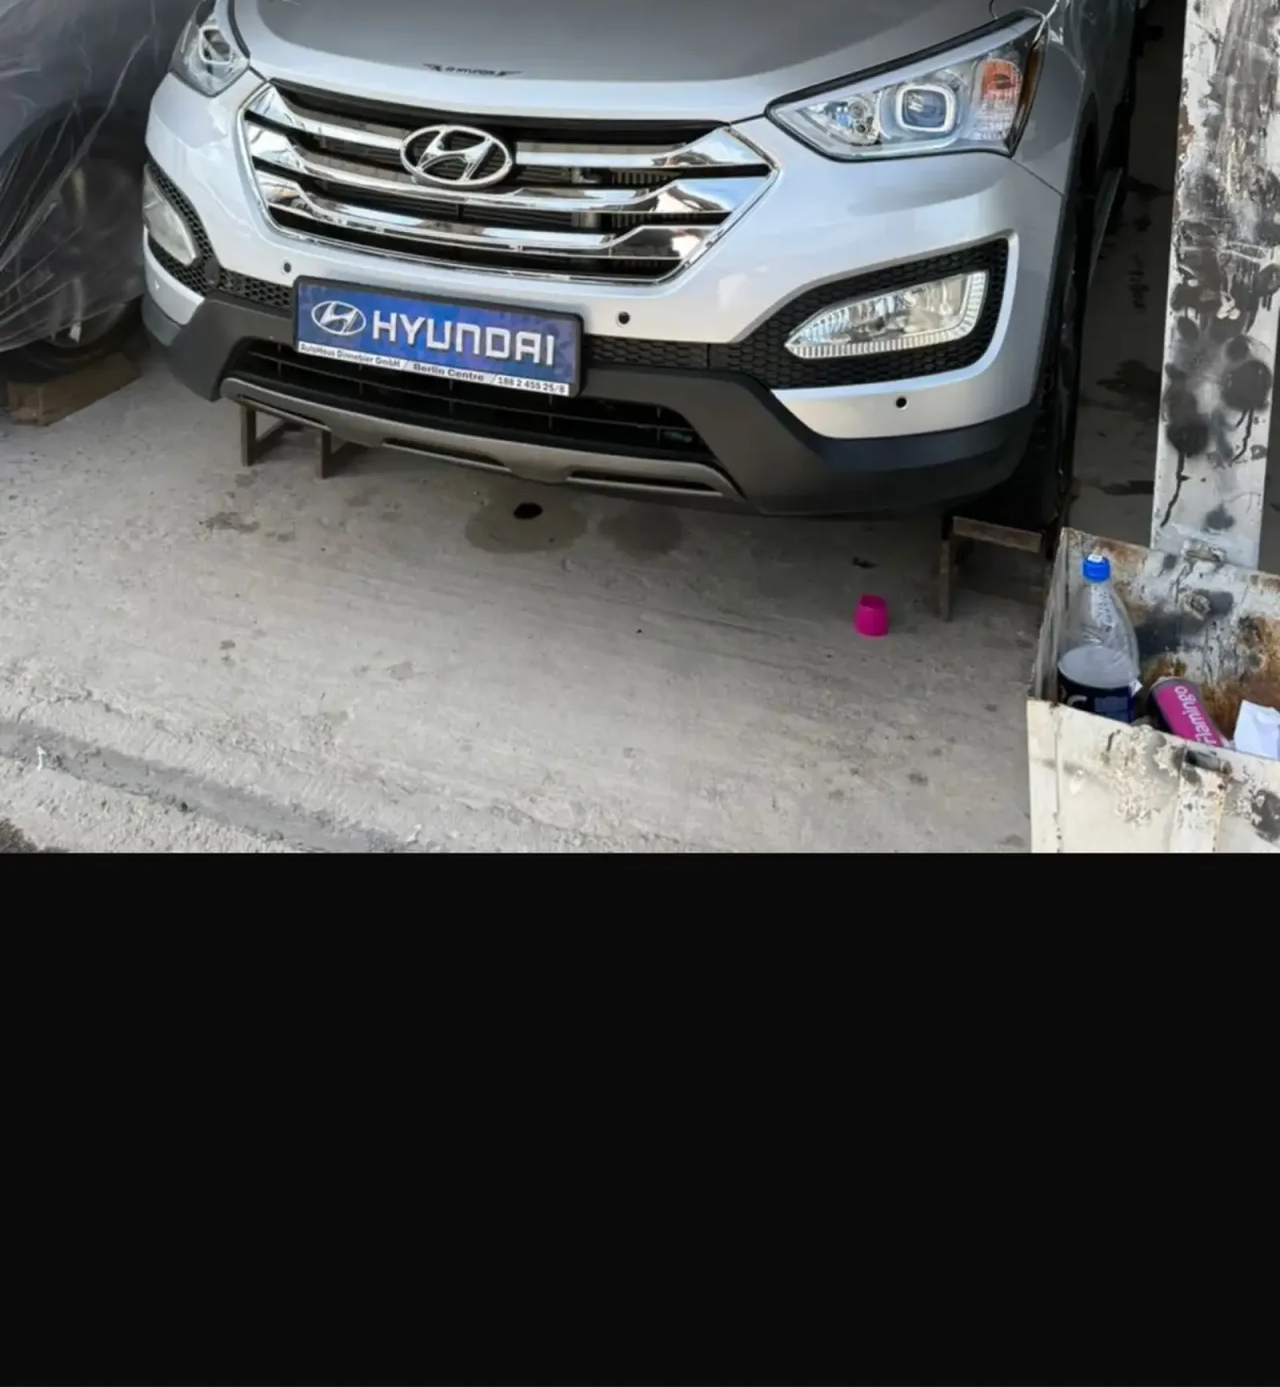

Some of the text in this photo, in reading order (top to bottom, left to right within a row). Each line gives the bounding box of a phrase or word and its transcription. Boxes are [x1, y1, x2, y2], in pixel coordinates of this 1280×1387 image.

[372, 310, 555, 366] HYUNDAI
[413, 363, 445, 376] Berlin
[447, 368, 485, 382] Centre
